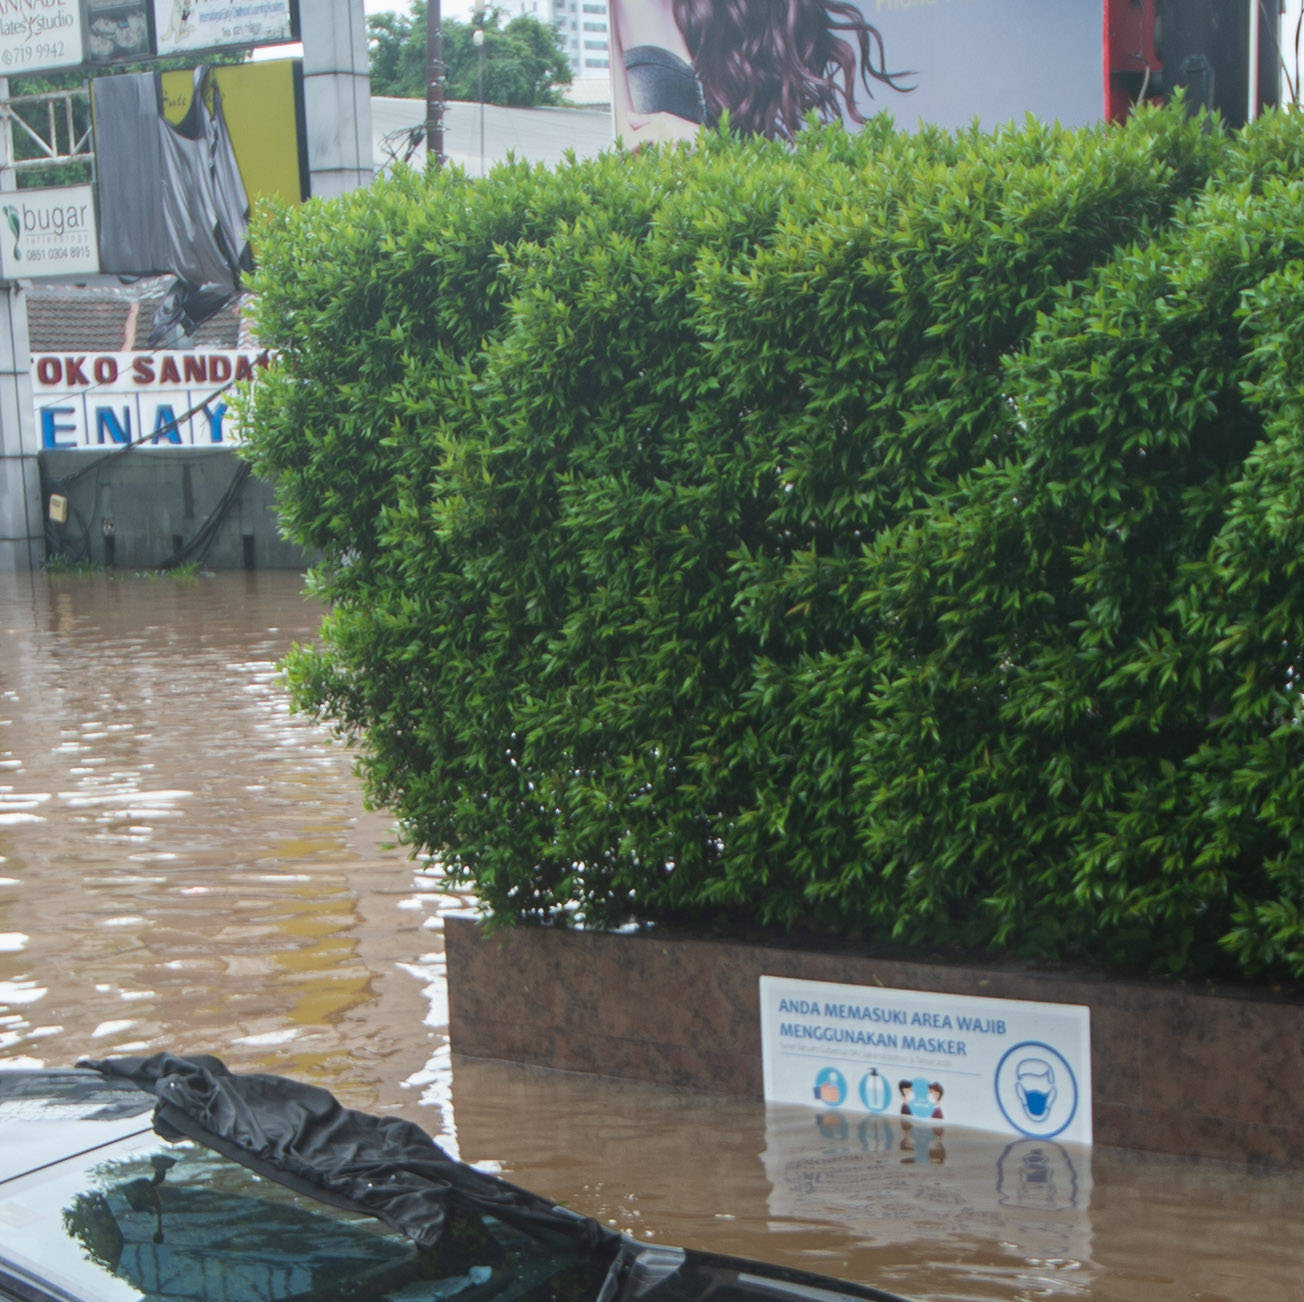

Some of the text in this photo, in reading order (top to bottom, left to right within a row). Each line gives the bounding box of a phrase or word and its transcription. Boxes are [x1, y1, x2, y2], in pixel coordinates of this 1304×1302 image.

[35, 10, 74, 32] studio
[14, 40, 65, 64] 719 9942
[22, 203, 88, 236] bugar
[30, 354, 118, 386] OKO
[779, 999, 1006, 1034] ANDA MEMASUKI AREA WAJIB
[780, 1023, 897, 1048] MENGGUNAKAN
[902, 1036, 967, 1055] MASKER
